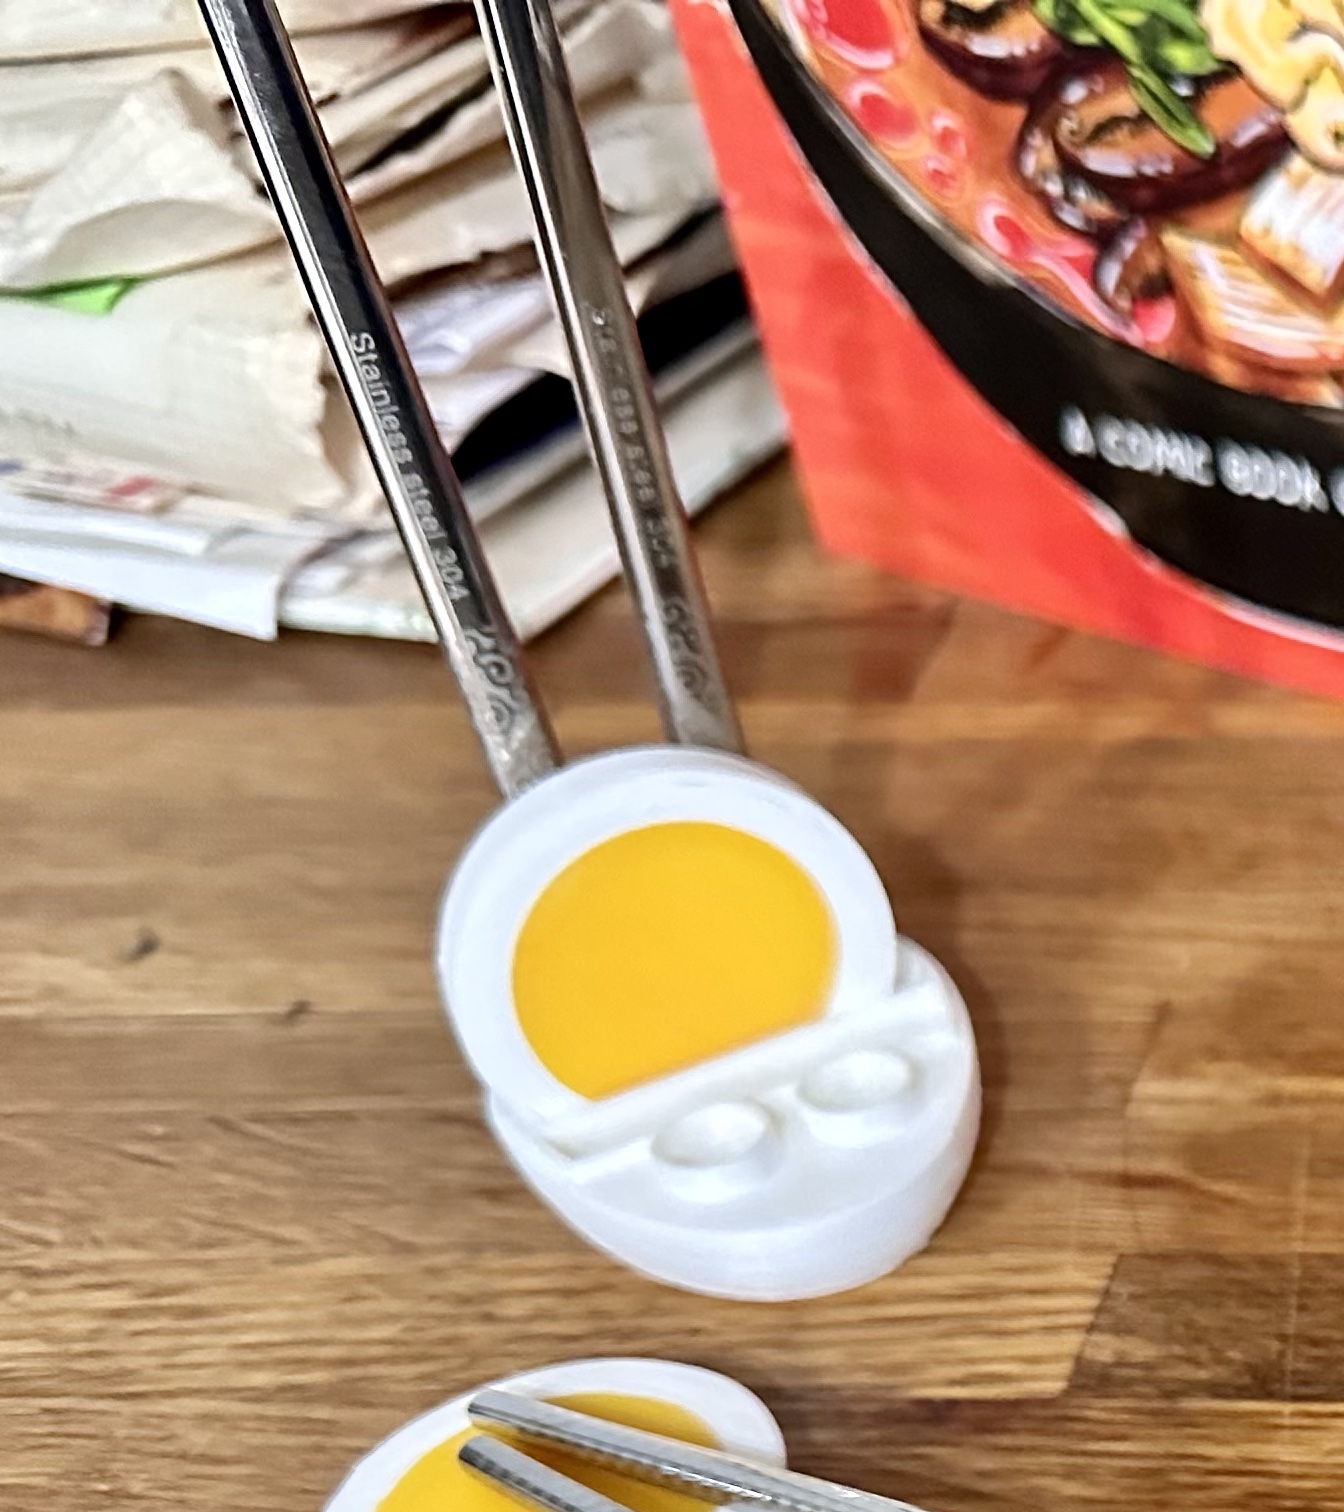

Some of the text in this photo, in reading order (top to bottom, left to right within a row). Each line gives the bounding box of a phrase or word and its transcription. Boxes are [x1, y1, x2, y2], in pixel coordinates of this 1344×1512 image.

[346, 330, 472, 601] Stainless steel 304
[1217, 438, 1329, 512] BOOK
